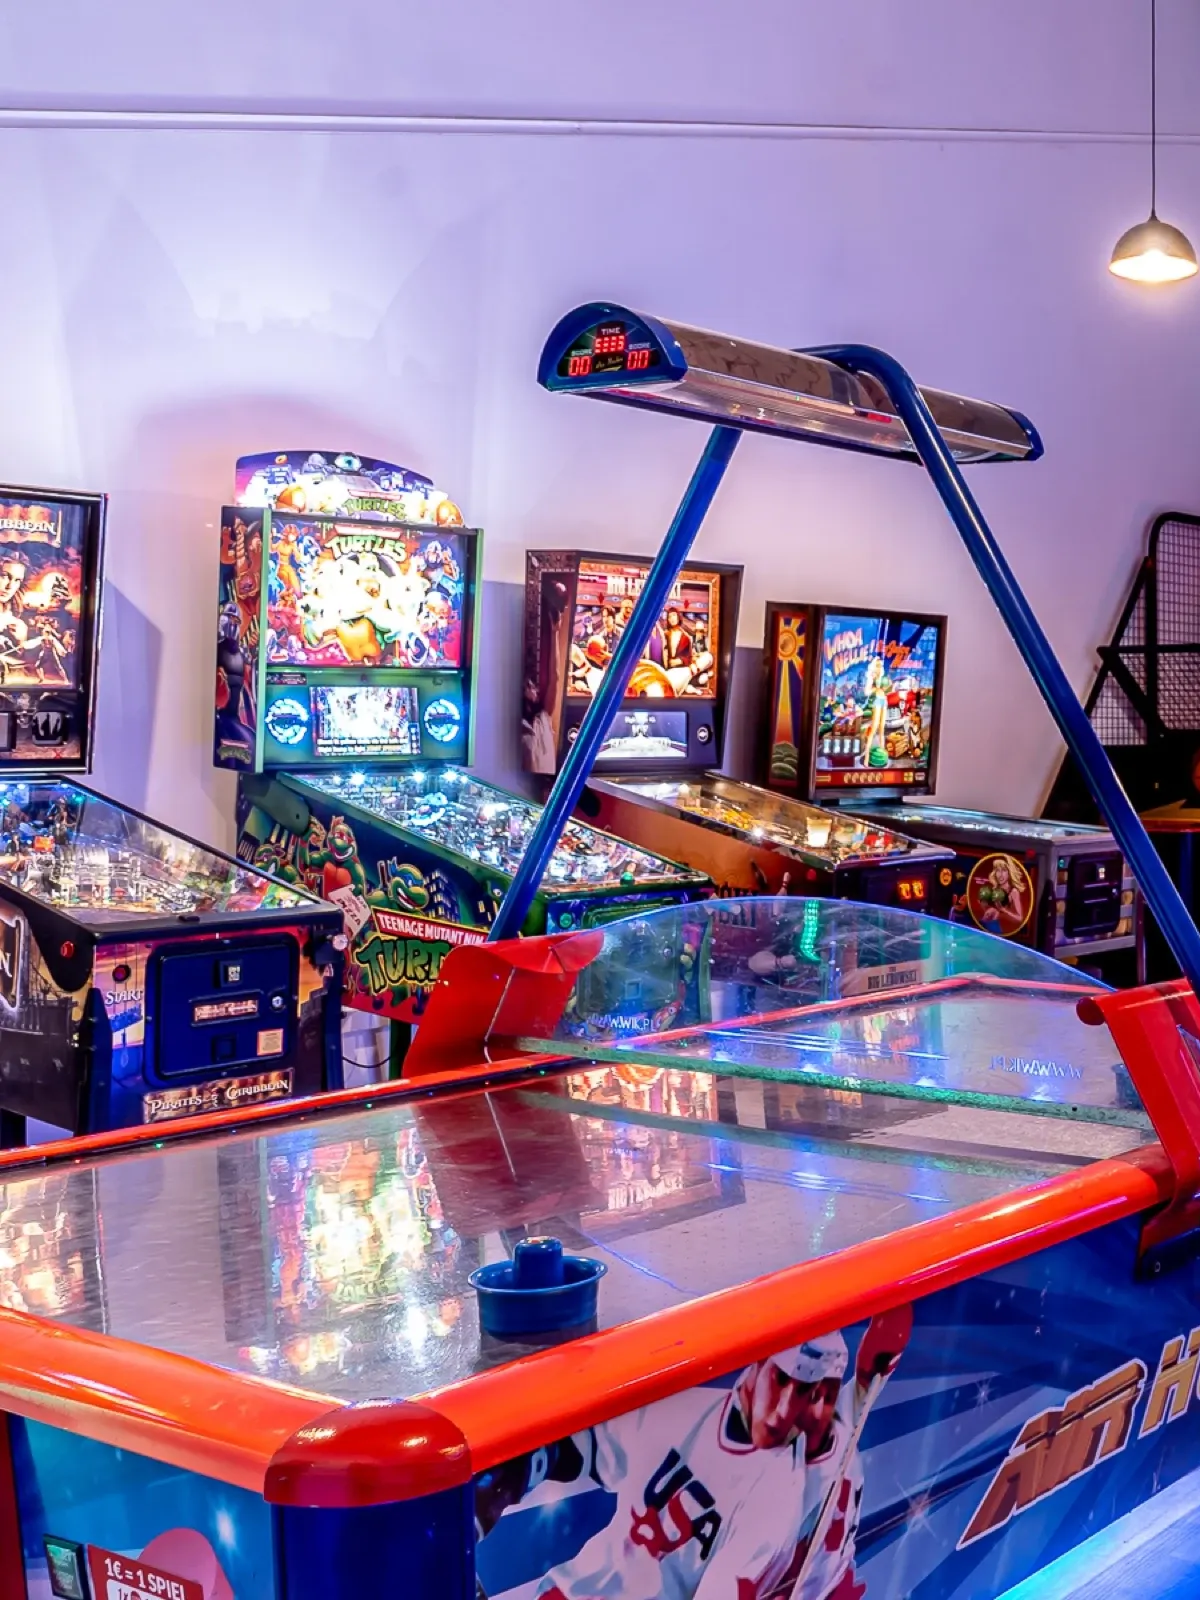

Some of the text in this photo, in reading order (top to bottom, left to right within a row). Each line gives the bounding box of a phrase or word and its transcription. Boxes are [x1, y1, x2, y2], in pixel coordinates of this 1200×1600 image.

[601, 327, 620, 336] TIME
[341, 498, 407, 520] TURTLES
[324, 535, 407, 563] TURTLES
[376, 912, 424, 938] TEENAGE
[424, 923, 464, 945] MUTANT
[355, 935, 453, 994] TURT
[104, 989, 143, 1006] START
[150, 1095, 203, 1114] PIRATES
[956, 1358, 1149, 1551] AIR
[104, 1558, 123, 1580] 1€
[136, 1569, 146, 1589] 1
